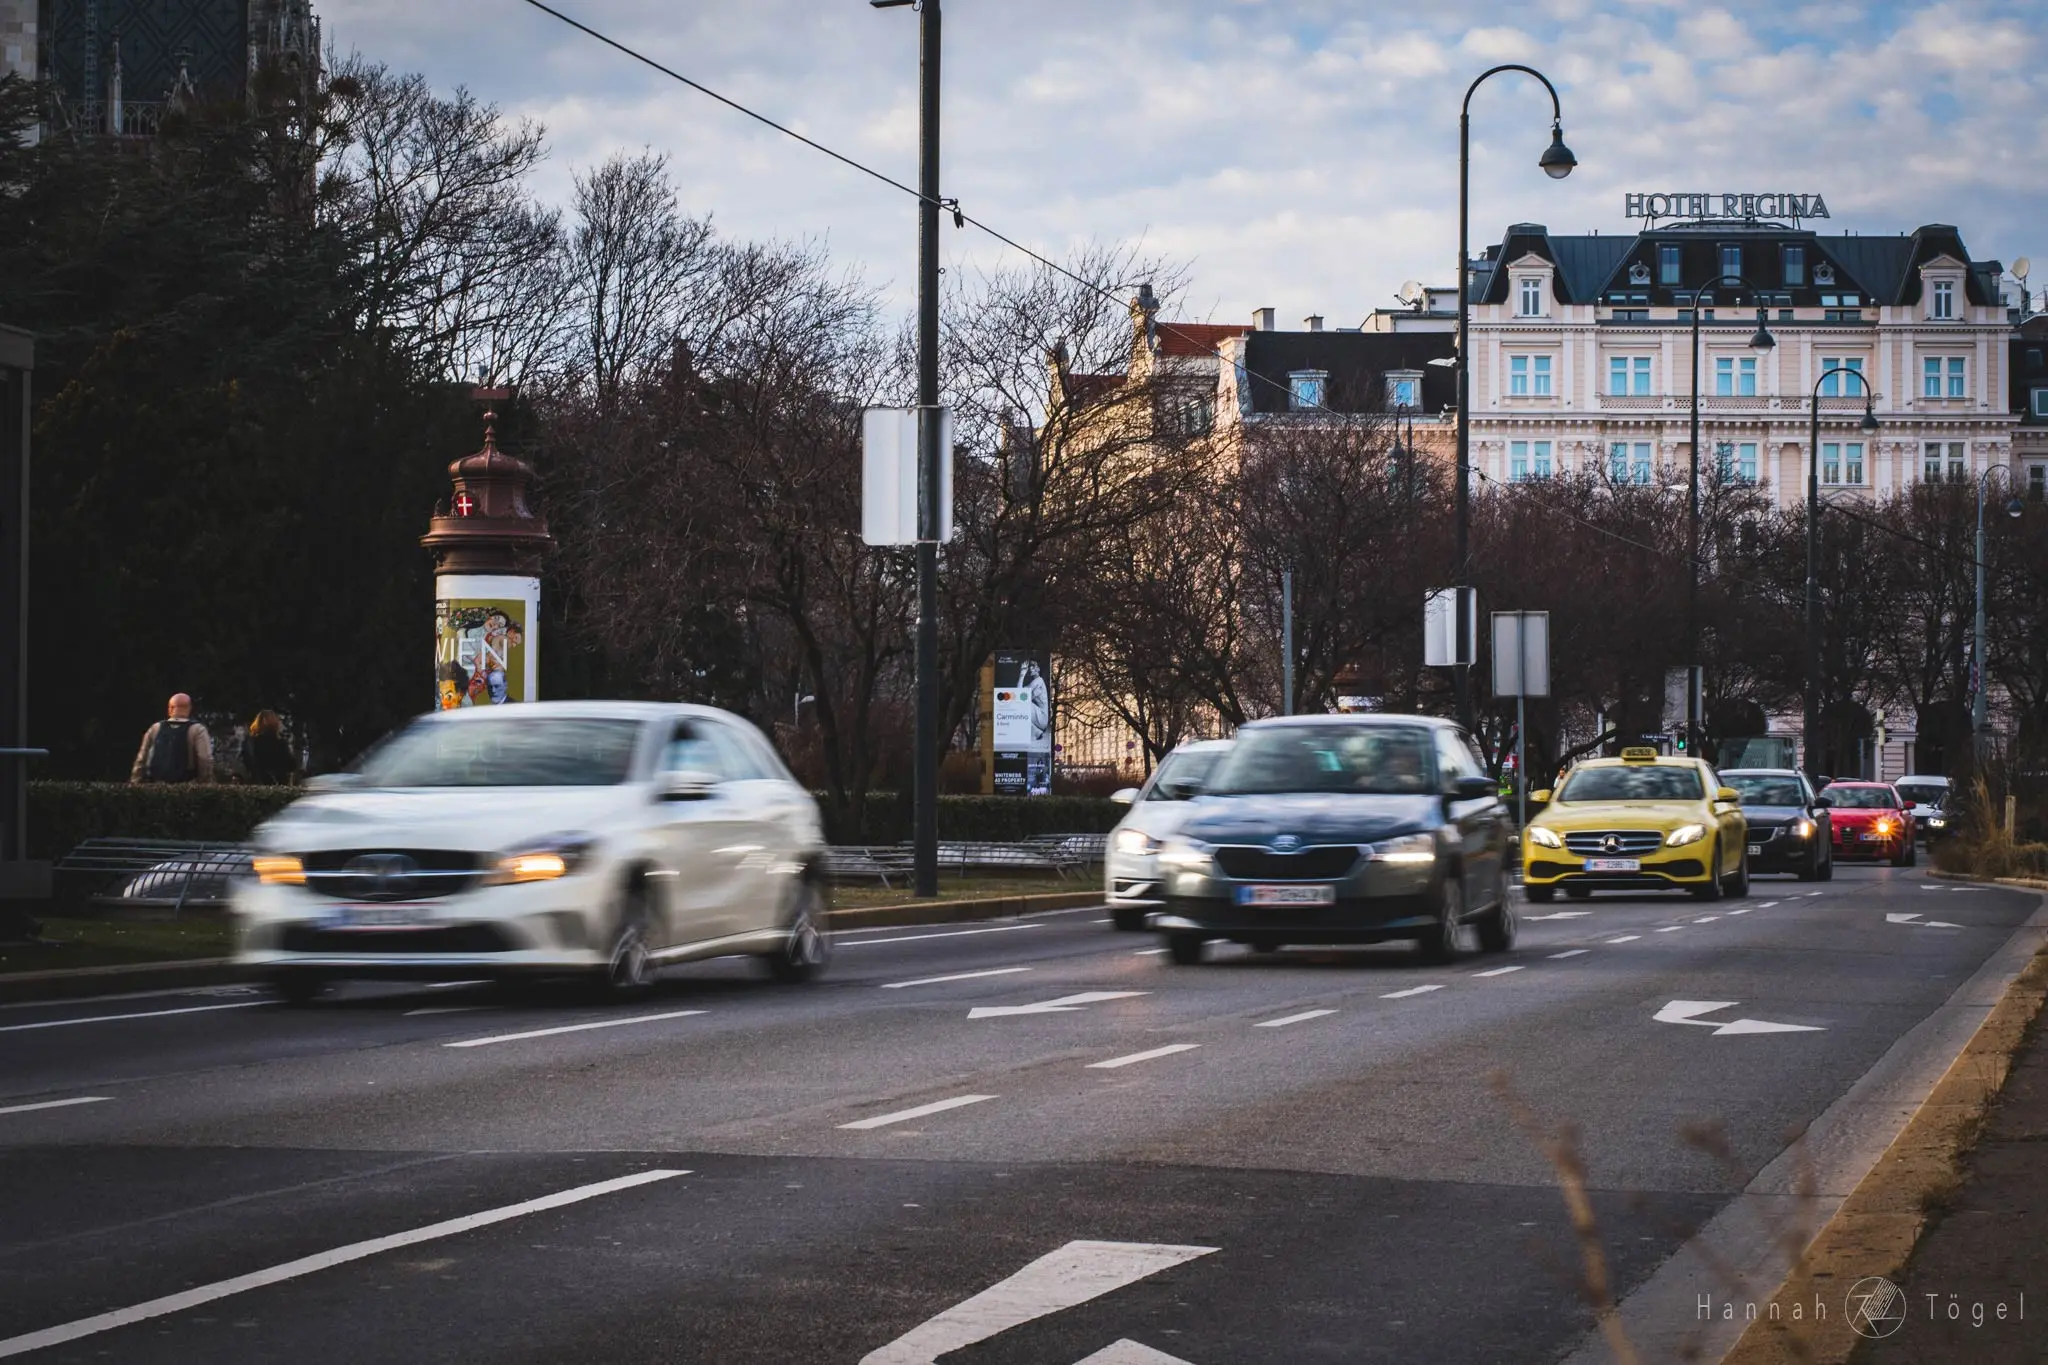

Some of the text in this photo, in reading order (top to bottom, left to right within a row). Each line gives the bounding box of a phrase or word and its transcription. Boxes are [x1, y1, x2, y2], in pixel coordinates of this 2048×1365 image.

[1625, 193, 1830, 218] HOTEL REGINA
[996, 713, 1029, 721] Carminho
